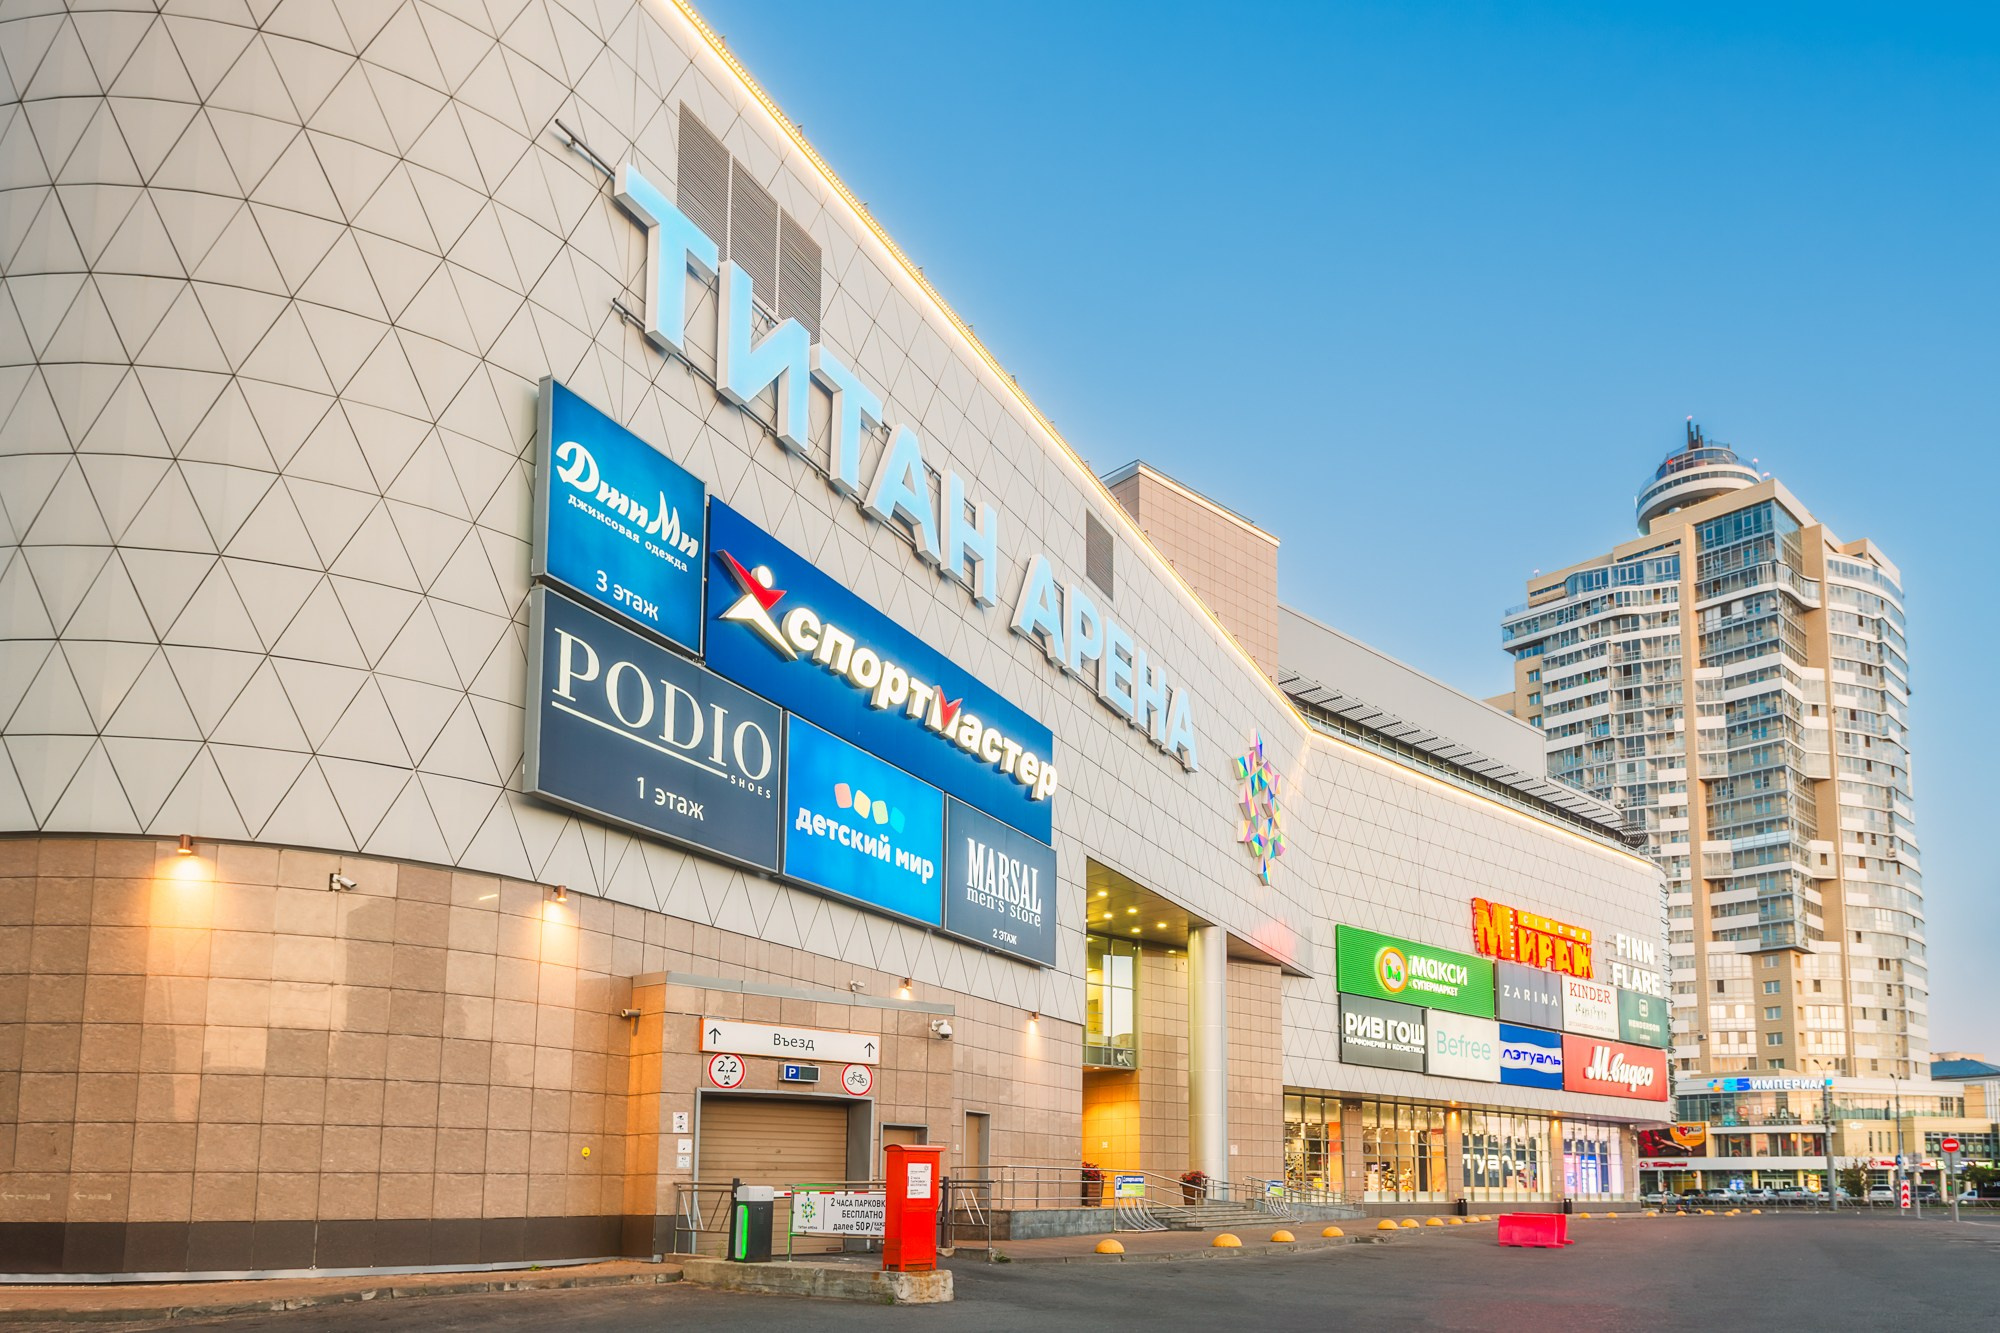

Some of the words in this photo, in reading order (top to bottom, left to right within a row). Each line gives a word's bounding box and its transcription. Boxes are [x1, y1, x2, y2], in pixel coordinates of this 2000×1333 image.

[614, 163, 997, 607] ТИТАН
[1010, 554, 1198, 772] АРЕНА
[568, 494, 640, 544] джинсовая
[645, 541, 688, 572] одежда
[596, 570, 608, 592] 3
[613, 583, 659, 621] этаж
[552, 628, 772, 780] PODIO
[637, 777, 645, 799] 1
[654, 788, 704, 821] этаж
[731, 775, 771, 799] SHOES
[795, 807, 891, 862] детский
[896, 848, 934, 884] мир
[967, 838, 1042, 914] MARSAL
[967, 886, 1005, 913] men's
[1010, 900, 1041, 927] store
[992, 928, 998, 938] 2
[999, 931, 1018, 945] ЭТАЖ
[1522, 915, 1588, 941] CINEMA
[1615, 933, 1655, 966] FINN
[1411, 979, 1459, 997] СУПЕРМАРКЕТ
[1569, 982, 1611, 1005] KINDER
[1612, 962, 1661, 996] FLARE
[1503, 985, 1559, 1007] ZARINA
[773, 1033, 815, 1051] Въезд
[1344, 1012, 1385, 1039] РИВ
[1386, 1019, 1425, 1046] ГОШ
[1436, 1030, 1491, 1060] Befree
[717, 1060, 737, 1073] 2,2
[1585, 1045, 1654, 1092] М.видео
[830, 1198, 835, 1206] 2
[837, 1199, 853, 1207] ЧАСА
[854, 1200, 886, 1208] ПАРКОВК
[842, 1210, 883, 1219] БЕСПЛАТНО
[833, 1223, 853, 1231] далее
